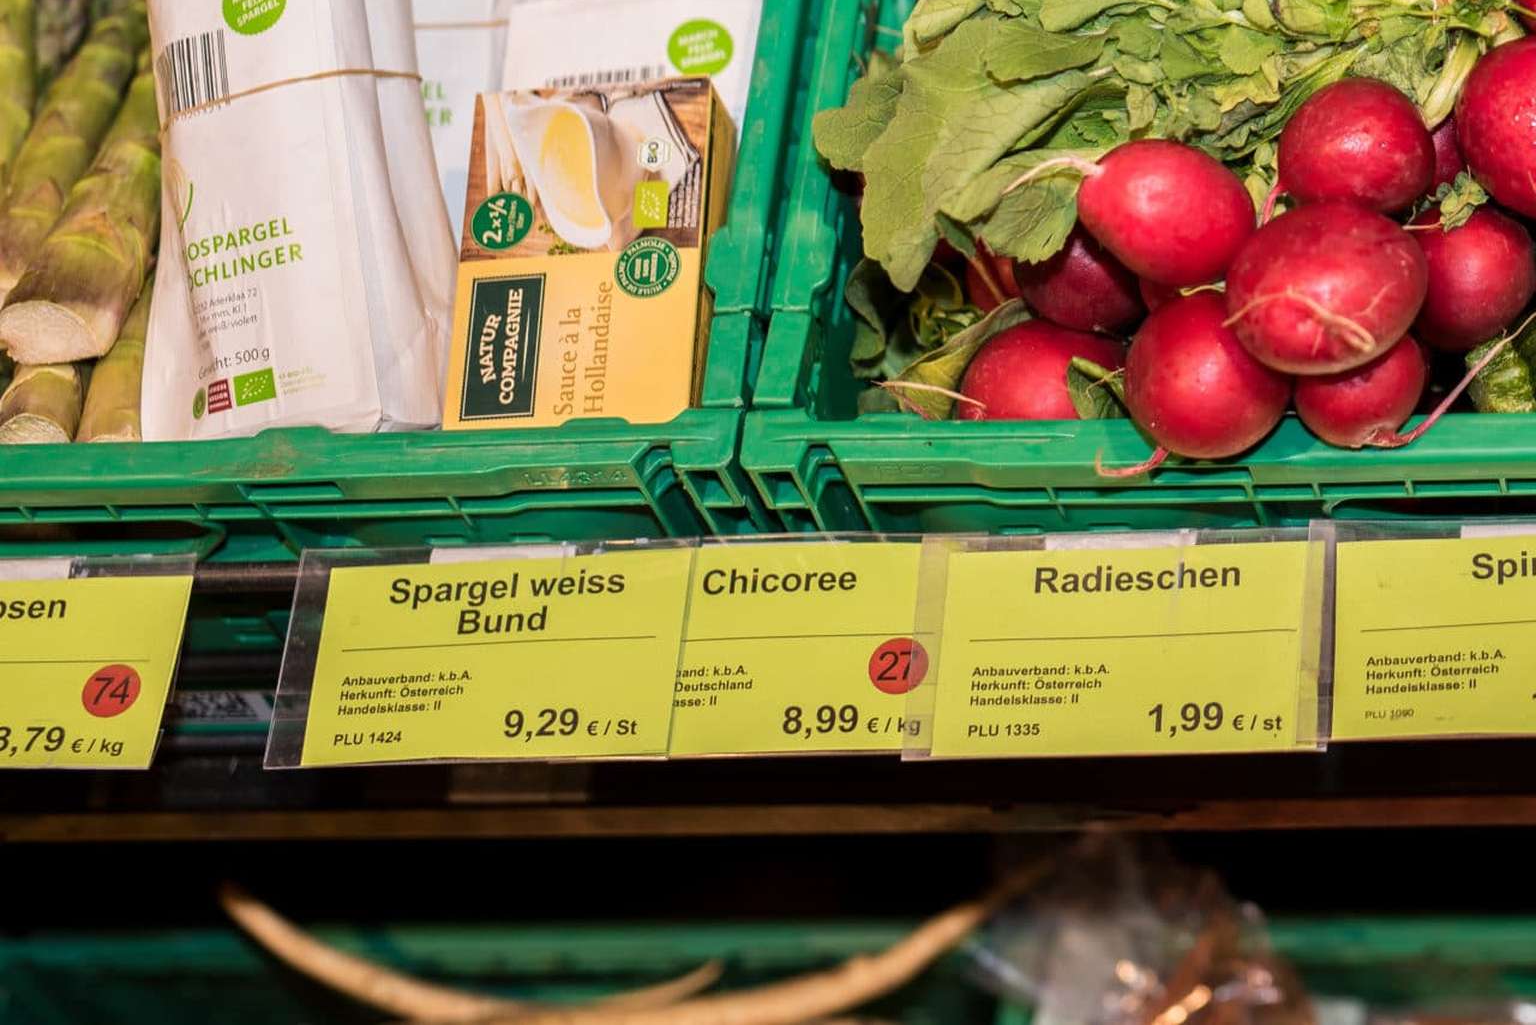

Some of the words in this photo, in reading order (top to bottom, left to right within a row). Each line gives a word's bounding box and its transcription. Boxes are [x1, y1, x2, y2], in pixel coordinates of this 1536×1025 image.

[187, 217, 294, 261] OSPARGEL
[558, 306, 582, 328] la
[499, 287, 525, 406] COMPAGNIE
[556, 333, 580, 345] à
[583, 280, 614, 416] Hollandaise
[234, 347, 260, 365] 500
[261, 347, 271, 362] g
[480, 313, 502, 385] NATUR
[553, 350, 580, 417] Sauce
[702, 568, 857, 595] Chicoree
[1034, 562, 1241, 594] Radieschen
[389, 572, 519, 609] Spargel
[530, 569, 626, 597] weiss
[457, 606, 548, 635] Bund
[877, 651, 918, 680] 27
[1366, 651, 1466, 666] Anbauverband:
[1469, 649, 1506, 661] k.b.A.
[342, 672, 436, 687] Anbauverband:
[438, 670, 473, 682] k.b.A.
[713, 665, 749, 676] k.b.A.
[972, 665, 1070, 677] Anbauverband:
[1074, 664, 1110, 675] k.b.A.
[1366, 667, 1427, 681] Herkunft:
[1430, 663, 1500, 677] Österreich
[93, 676, 130, 705] 74
[340, 688, 397, 702] Herkunft:
[400, 684, 464, 698] Österreich
[674, 679, 753, 692] Deutschland
[971, 679, 1030, 691] Herkunft:
[1034, 677, 1102, 690] Österreich
[1365, 681, 1465, 695] Handelsklasse:
[1468, 679, 1477, 690] II
[337, 701, 430, 716] Handelsklasse:
[433, 700, 441, 712] II
[969, 693, 1067, 707] Handelsklasse:
[1071, 693, 1079, 704] II
[782, 704, 858, 739] 8,99
[1148, 701, 1223, 737] 1,99
[1364, 709, 1386, 719] PLU
[503, 708, 579, 743] 9,29
[967, 724, 1000, 737] PLU
[1004, 723, 1040, 736] 1335
[333, 732, 363, 746] PLU
[368, 731, 402, 744] 1424
